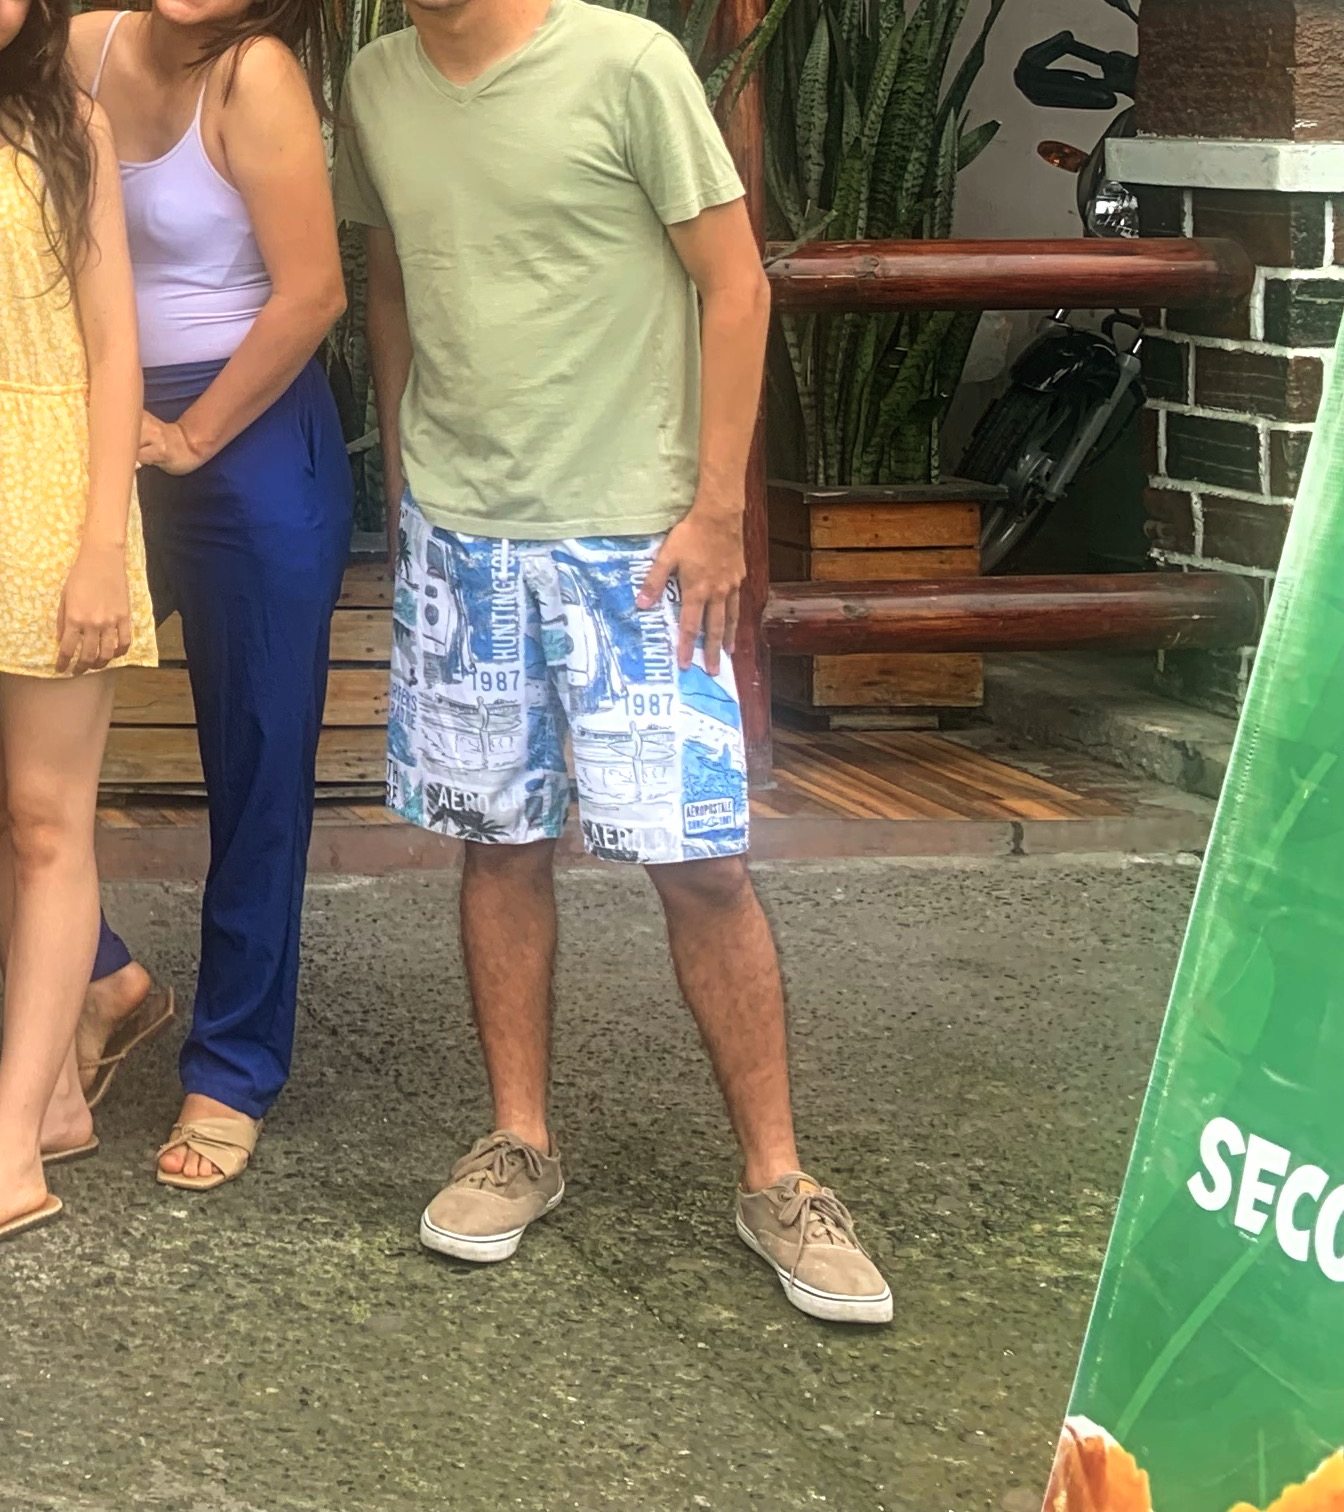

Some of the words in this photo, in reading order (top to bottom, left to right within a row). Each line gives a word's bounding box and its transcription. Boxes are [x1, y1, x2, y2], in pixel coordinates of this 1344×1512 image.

[472, 670, 520, 692] 1987
[624, 693, 674, 716] 1987
[438, 786, 490, 813] AERO
